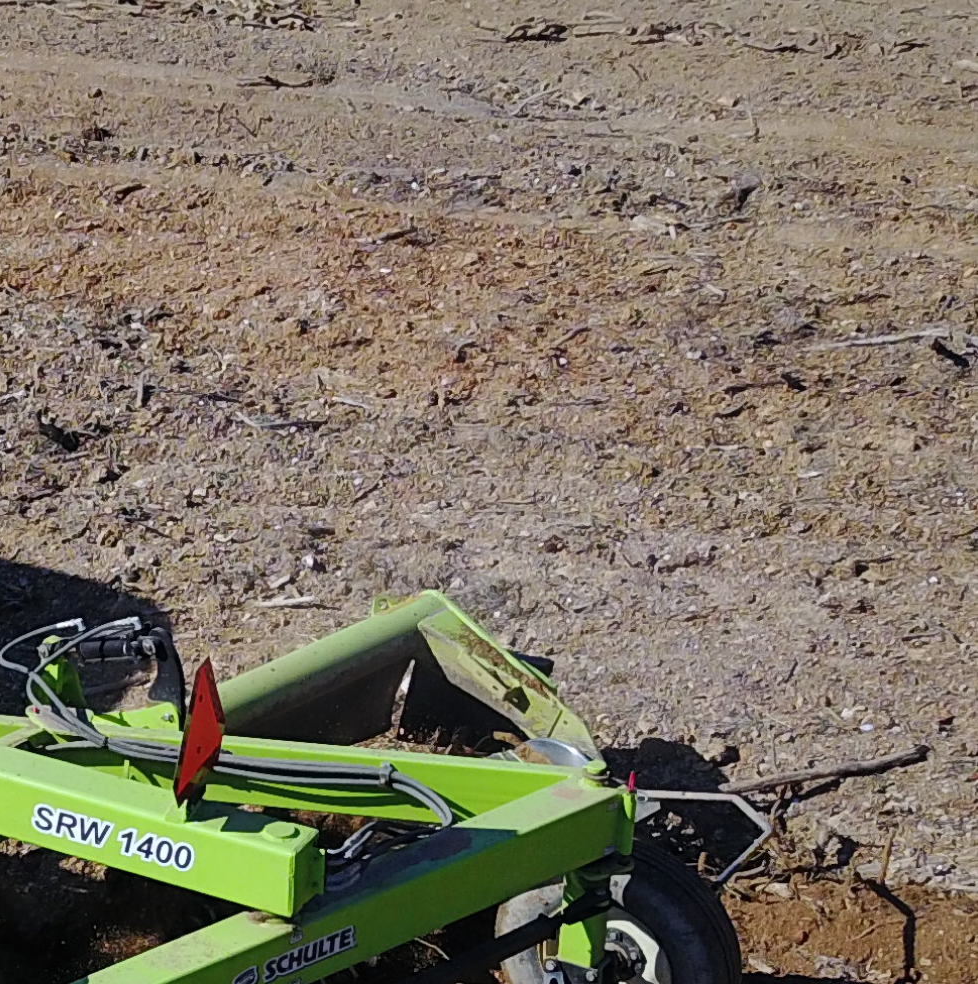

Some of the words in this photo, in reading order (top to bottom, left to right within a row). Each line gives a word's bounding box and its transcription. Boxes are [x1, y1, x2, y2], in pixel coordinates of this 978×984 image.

[33, 806, 111, 846] SRW
[120, 830, 193, 870] 1400
[263, 926, 353, 982] SCHULTE
